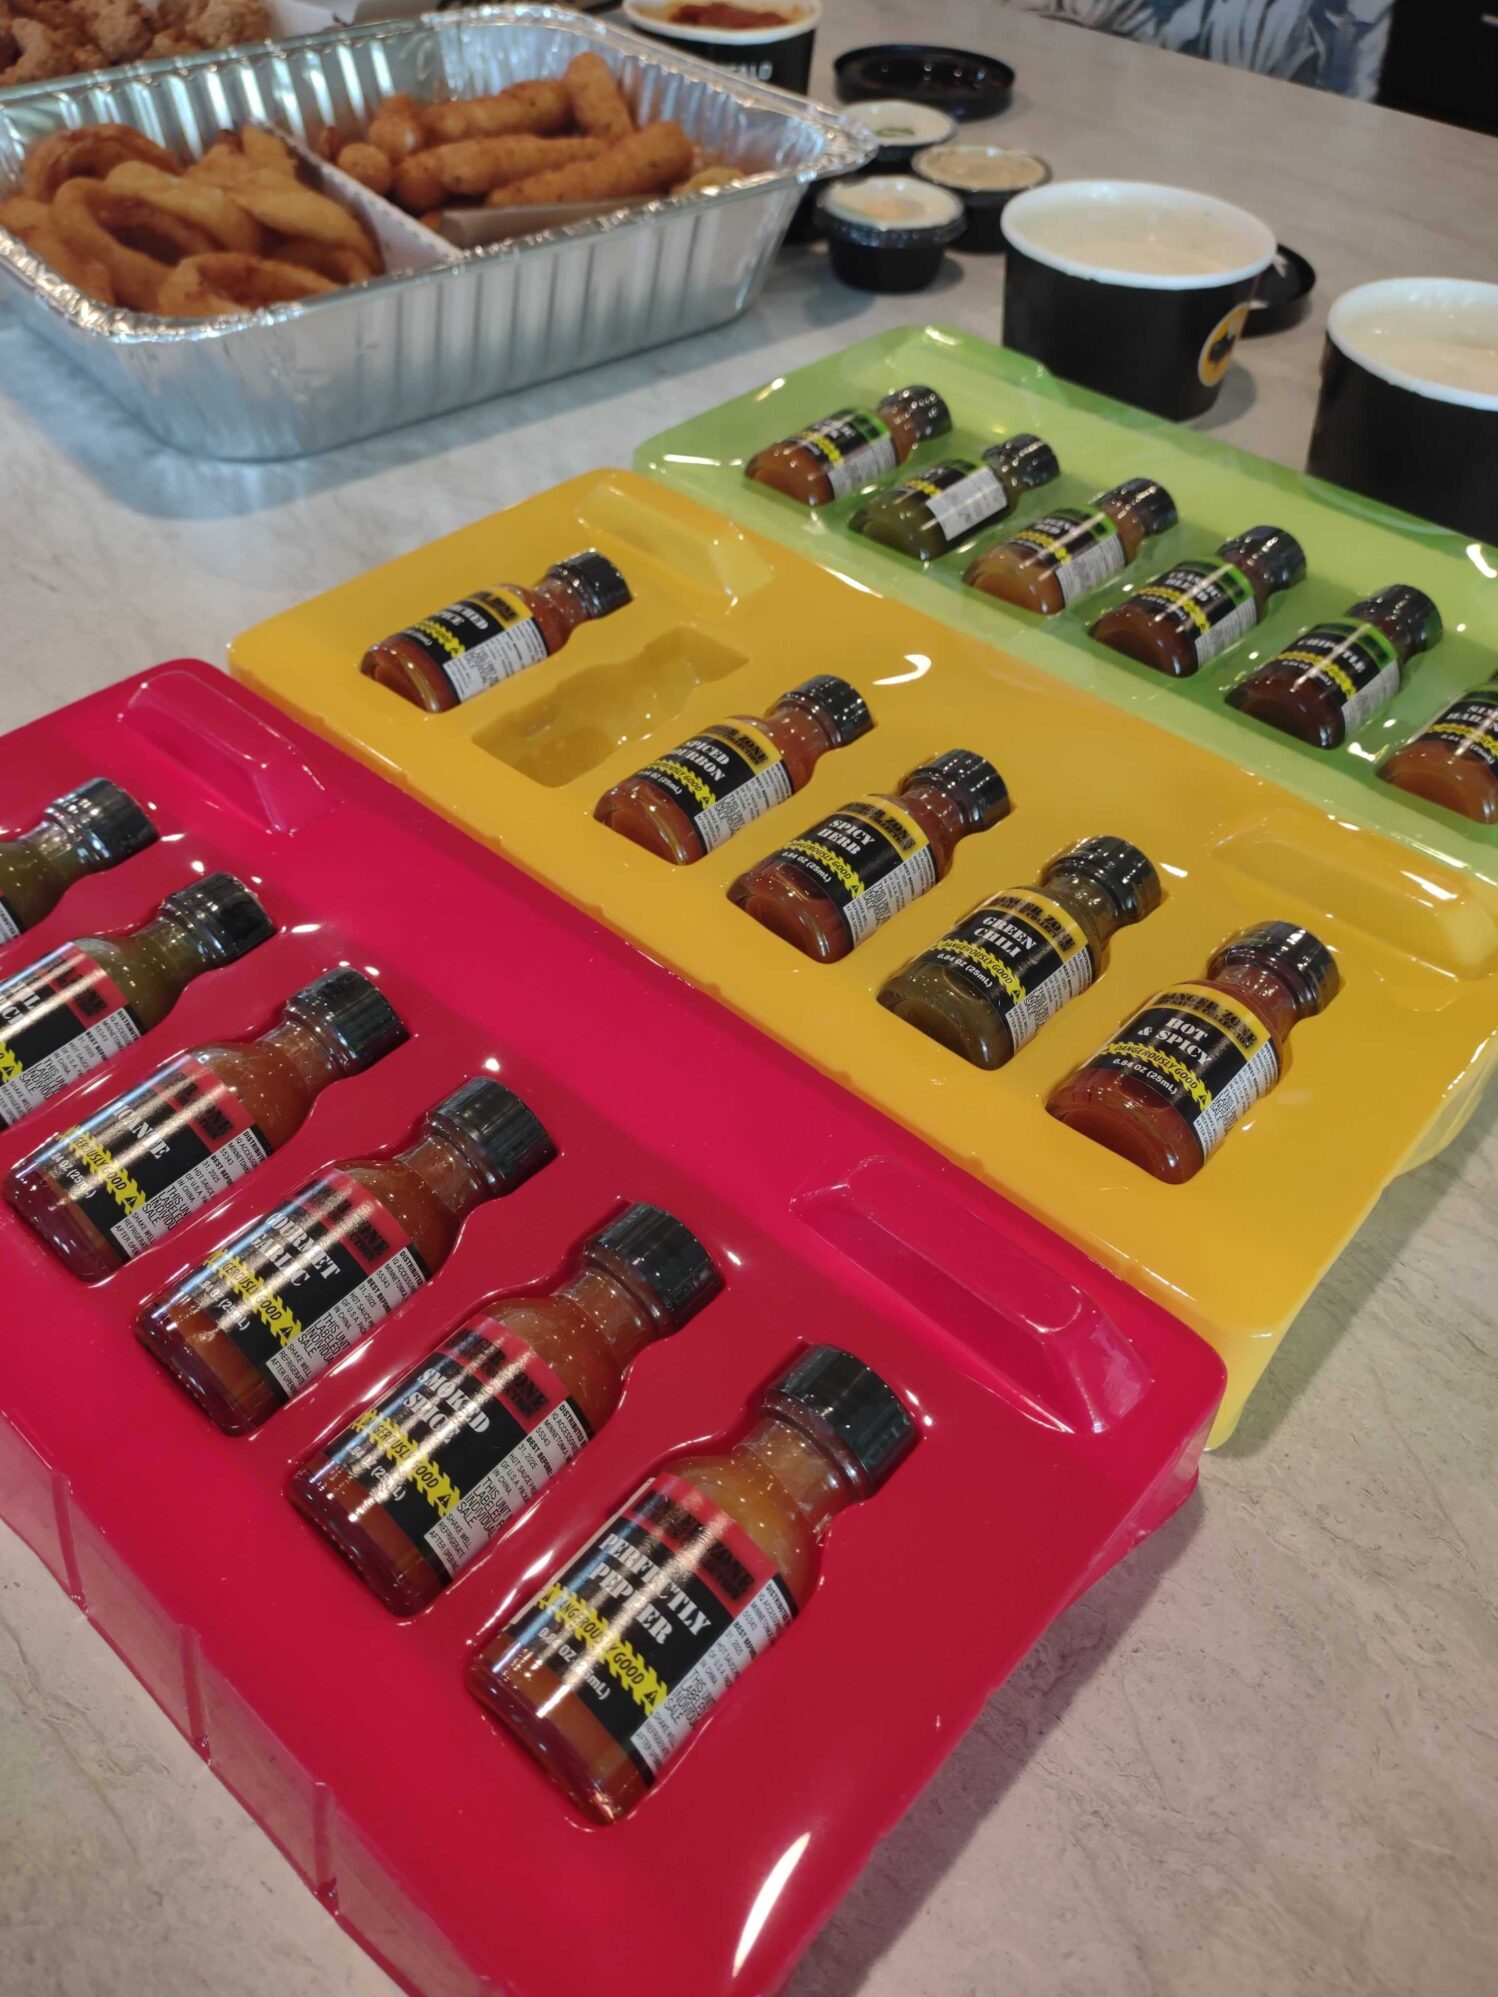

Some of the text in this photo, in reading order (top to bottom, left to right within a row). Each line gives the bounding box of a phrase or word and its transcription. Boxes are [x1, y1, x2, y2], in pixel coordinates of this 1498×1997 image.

[672, 748, 725, 781] OURBON
[686, 740, 730, 763] SPICED
[683, 774, 701, 792] GOOD
[816, 828, 862, 856] HERB
[828, 817, 875, 846] SPICY
[792, 841, 851, 880] ANGEROUSLY GOOD
[796, 855, 807, 864] OZ
[806, 860, 831, 883] (25mL)
[972, 926, 1021, 958] CHILI
[981, 915, 1037, 950] GREEN
[953, 957, 966, 968] OZ
[964, 963, 993, 989] (25mL)
[991, 962, 1013, 984] GOOD
[1164, 1015, 1208, 1041] HOT
[1220, 1008, 1258, 1043] ZONE
[1138, 1027, 1212, 1064] & SPICY
[42, 1057, 59, 1077] THIS
[1112, 1057, 1177, 1095] 0.84 OZ (25mL)
[1121, 1044, 1197, 1089] DANGEROUSLY GOOD
[106, 1100, 170, 1159] ICANTE
[59, 1158, 72, 1172] OZ
[65, 1131, 127, 1191] GEROUSLY GOOD
[209, 1153, 224, 1171] BEST
[219, 1147, 234, 1166] 55343
[176, 1178, 185, 1187] IN
[184, 1172, 194, 1183] OF
[192, 1166, 215, 1197] HOT SAUCE
[207, 1168, 220, 1183] 2025
[165, 1184, 184, 1206] THIS
[131, 1211, 147, 1231] SHAKE
[141, 1202, 162, 1227] SALE.
[114, 1223, 131, 1242] AFTER
[264, 1211, 340, 1278] GOURMET
[248, 1230, 310, 1288] GARLIC
[194, 1274, 213, 1293] .84
[209, 1287, 224, 1302] OZ
[211, 1253, 283, 1321] GEROUSLY GOOD
[365, 1277, 380, 1294] BEST
[375, 1269, 391, 1289] 55343
[332, 1304, 341, 1314] IN
[340, 1298, 351, 1309] OF
[348, 1291, 371, 1322] HOT SAUCE
[357, 1283, 377, 1308] 31, 2025
[296, 1332, 318, 1359] SALE.
[304, 1325, 335, 1365] INDIVIDUA
[313, 1319, 341, 1355] LABELED
[321, 1312, 351, 1351] THIS UNIT
[269, 1356, 286, 1377] AFTER
[277, 1349, 305, 1386] REFRIGERATE
[286, 1343, 303, 1363] SHAKE
[416, 1366, 489, 1432] SMOKED
[402, 1391, 461, 1445] SPICE
[557, 1404, 585, 1442] DISTRIBUTED
[534, 1426, 551, 1447] 55343
[542, 1418, 571, 1458] MINNETONKA,
[345, 1439, 365, 1460] .84
[360, 1453, 377, 1470] OZ
[360, 1415, 439, 1490] DGEROUSLY GOOD
[500, 1460, 510, 1471] OF
[517, 1442, 538, 1469] 31, 2025
[525, 1435, 554, 1476] BEST BEFORE:
[491, 1467, 502, 1478] IN
[507, 1452, 532, 1485] HOT SAUCE
[472, 1484, 504, 1525] LABELED
[480, 1476, 511, 1517] THIS UNIT
[445, 1513, 463, 1534] SHAKE
[455, 1500, 479, 1529] SALE.
[463, 1491, 499, 1538] INDIVIDUAL
[428, 1528, 447, 1551] AFTER
[436, 1520, 465, 1559] REFRIGERATE
[587, 1561, 675, 1646] PEPPER
[537, 1625, 564, 1651] 0.84
[557, 1643, 577, 1662] OZ
[551, 1593, 646, 1686] DANGEROUY GOOD
[686, 1669, 707, 1692] THIS
